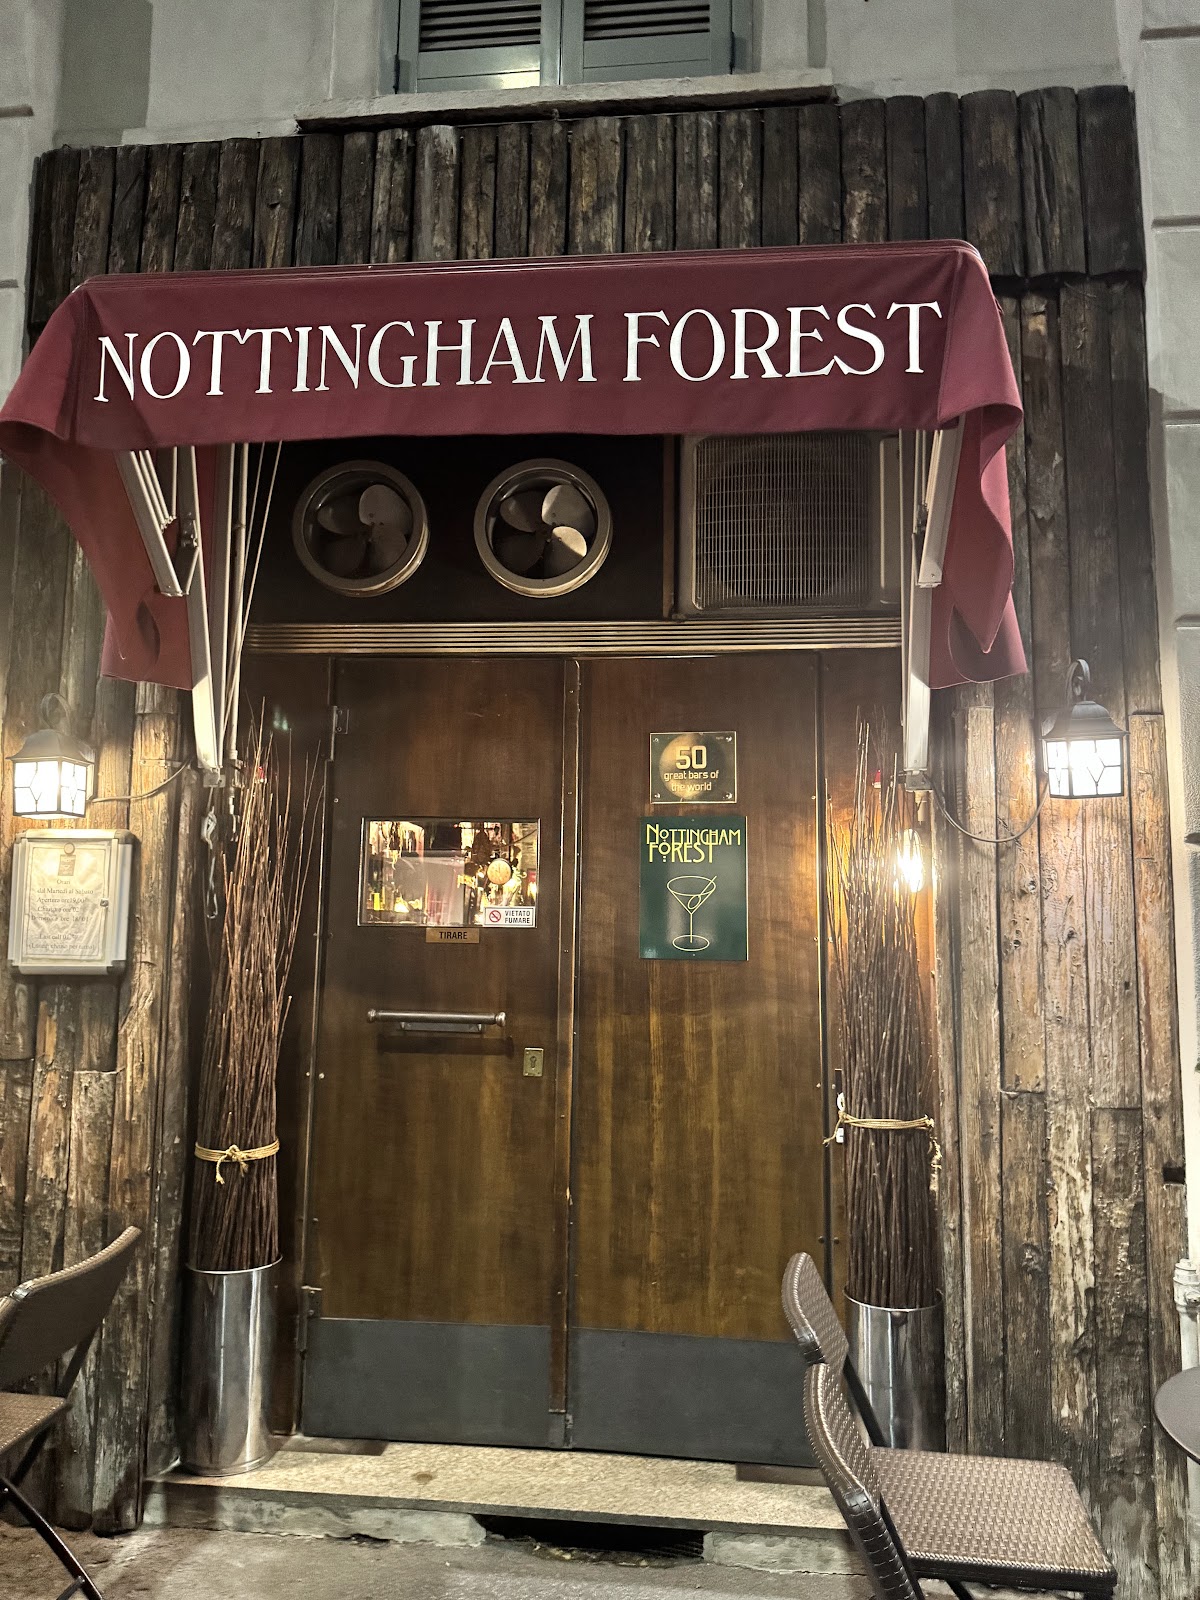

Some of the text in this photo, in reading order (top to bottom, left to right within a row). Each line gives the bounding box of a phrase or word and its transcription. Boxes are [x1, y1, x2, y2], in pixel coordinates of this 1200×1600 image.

[93, 300, 942, 404] NOTTINGHAM FOREST
[675, 745, 707, 770] 50
[663, 769, 720, 782] great bars of
[671, 781, 712, 792] the world
[438, 930, 468, 940] TIRARE
